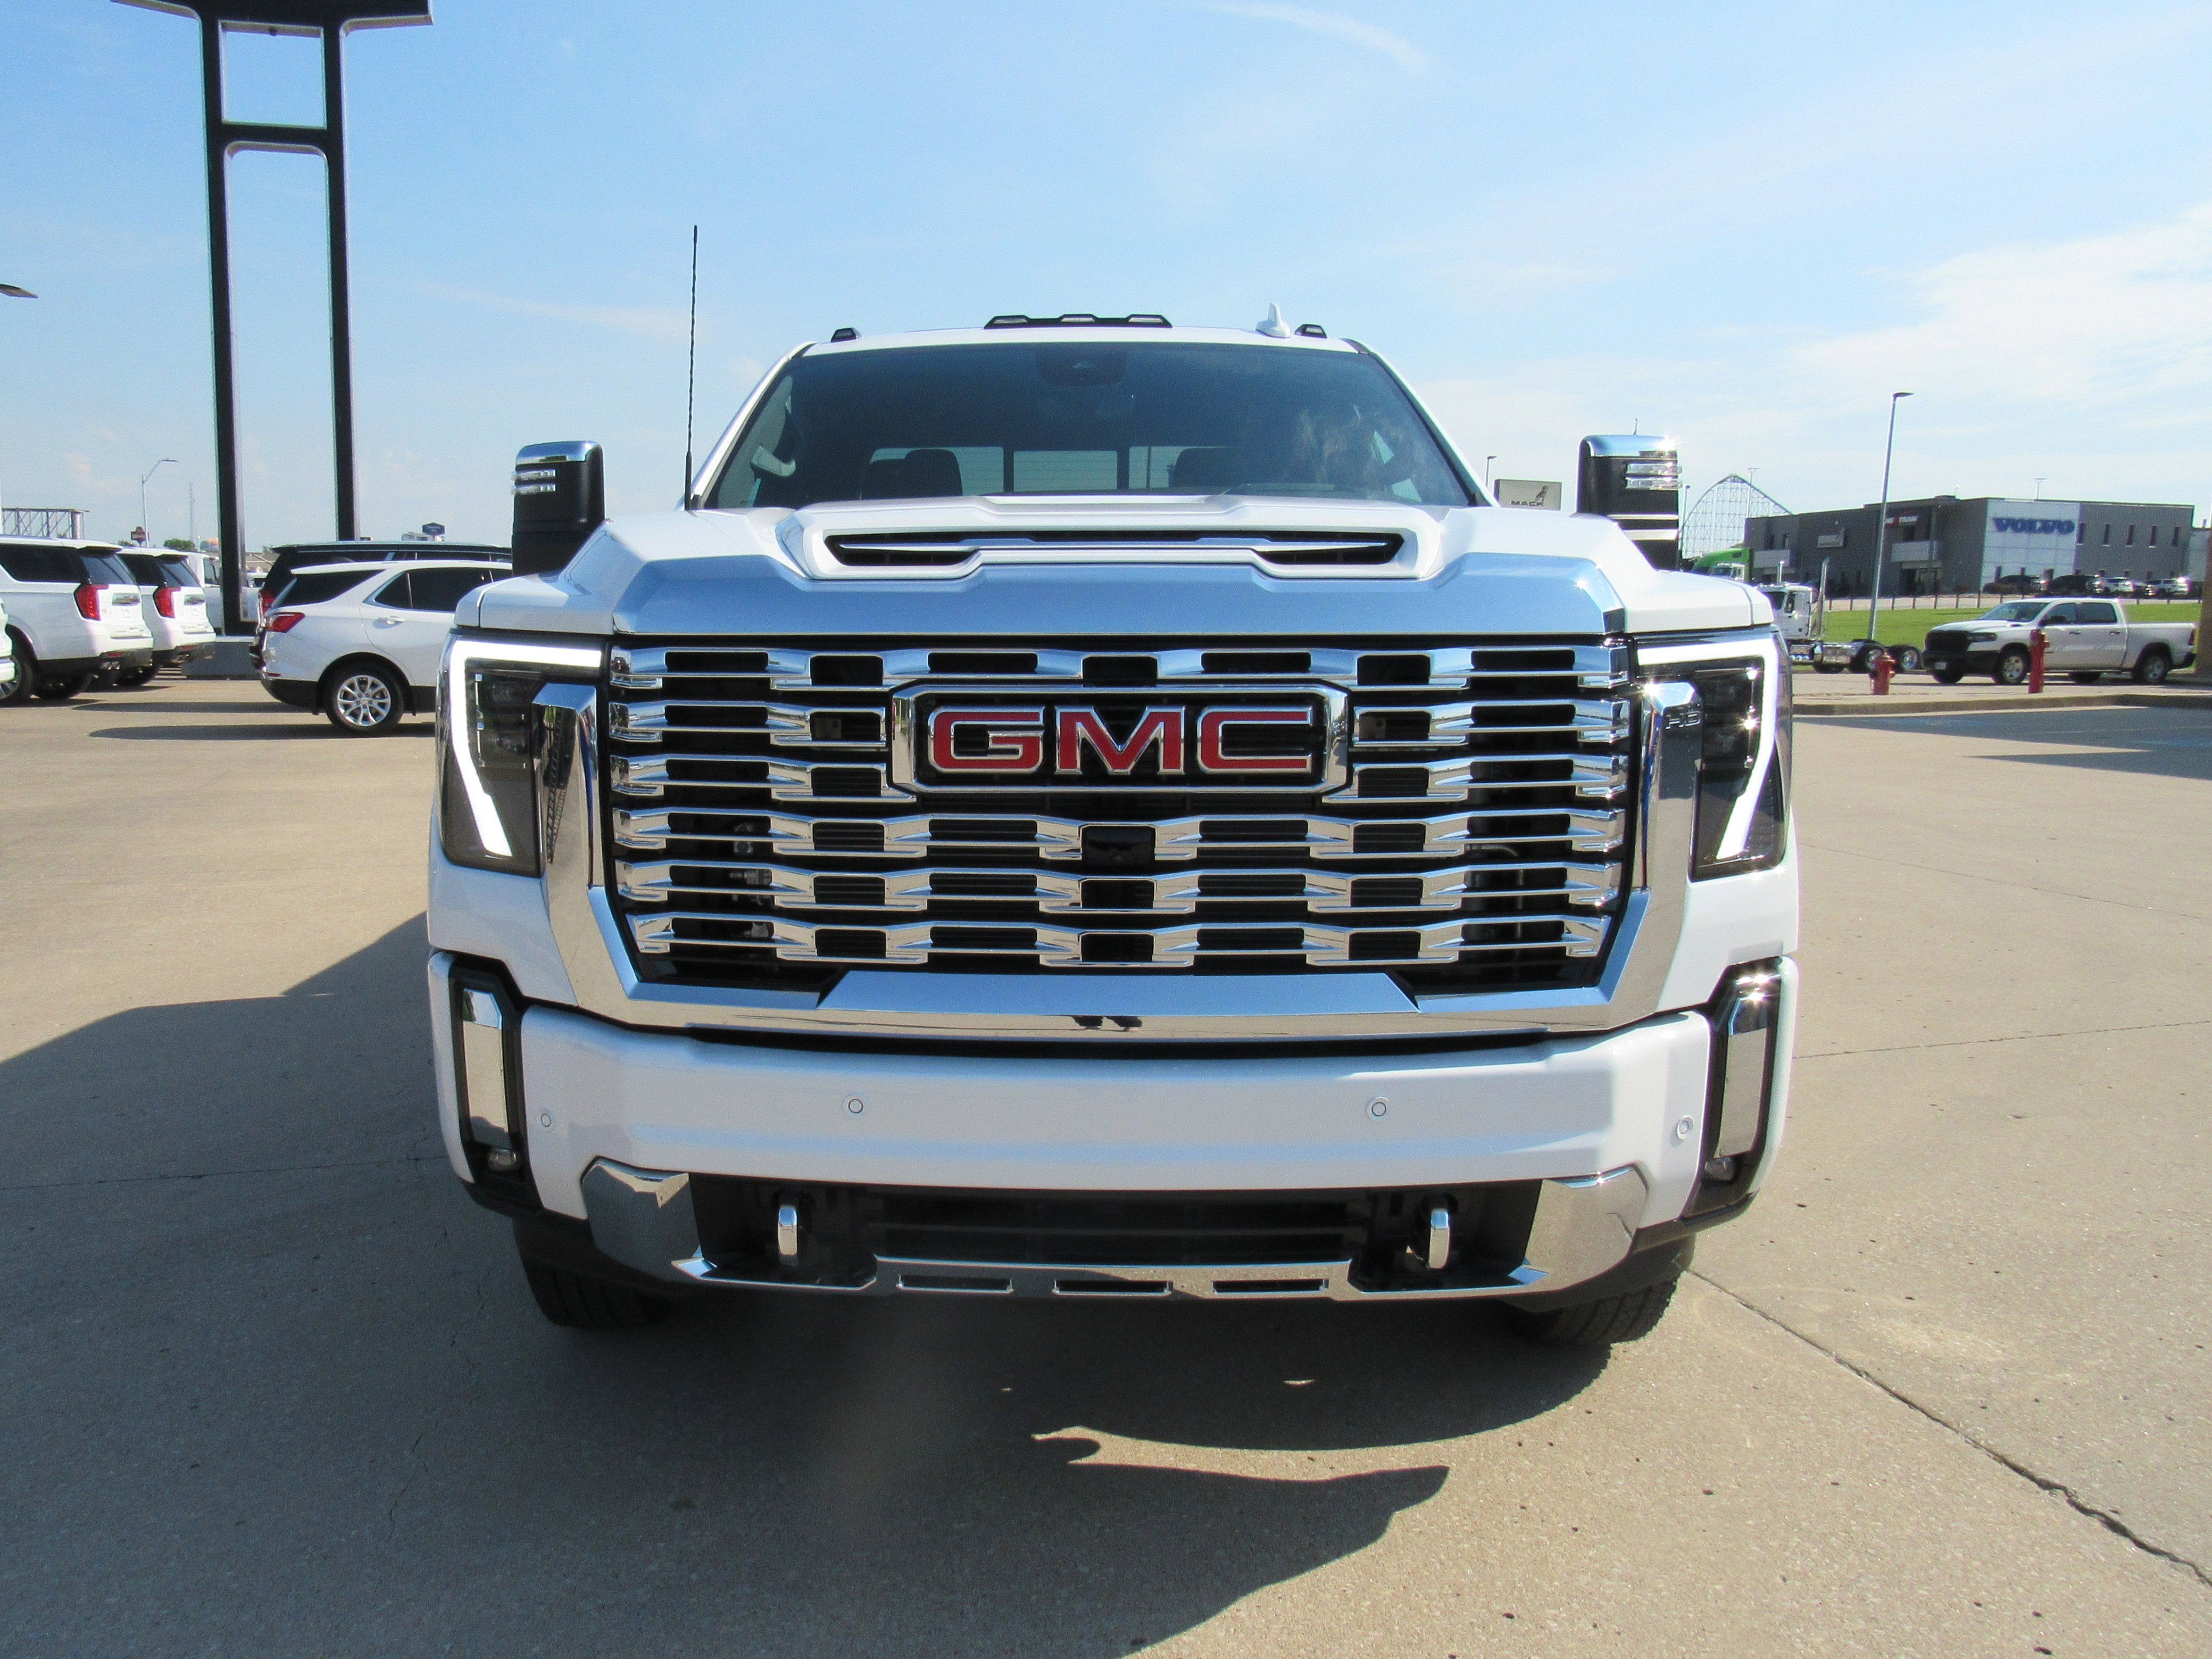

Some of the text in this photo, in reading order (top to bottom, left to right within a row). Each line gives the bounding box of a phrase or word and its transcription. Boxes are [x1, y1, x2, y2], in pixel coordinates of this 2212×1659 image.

[1992, 518, 2074, 534] VOLVO
[1665, 711, 1701, 729] HD
[928, 706, 1313, 775] GMC
